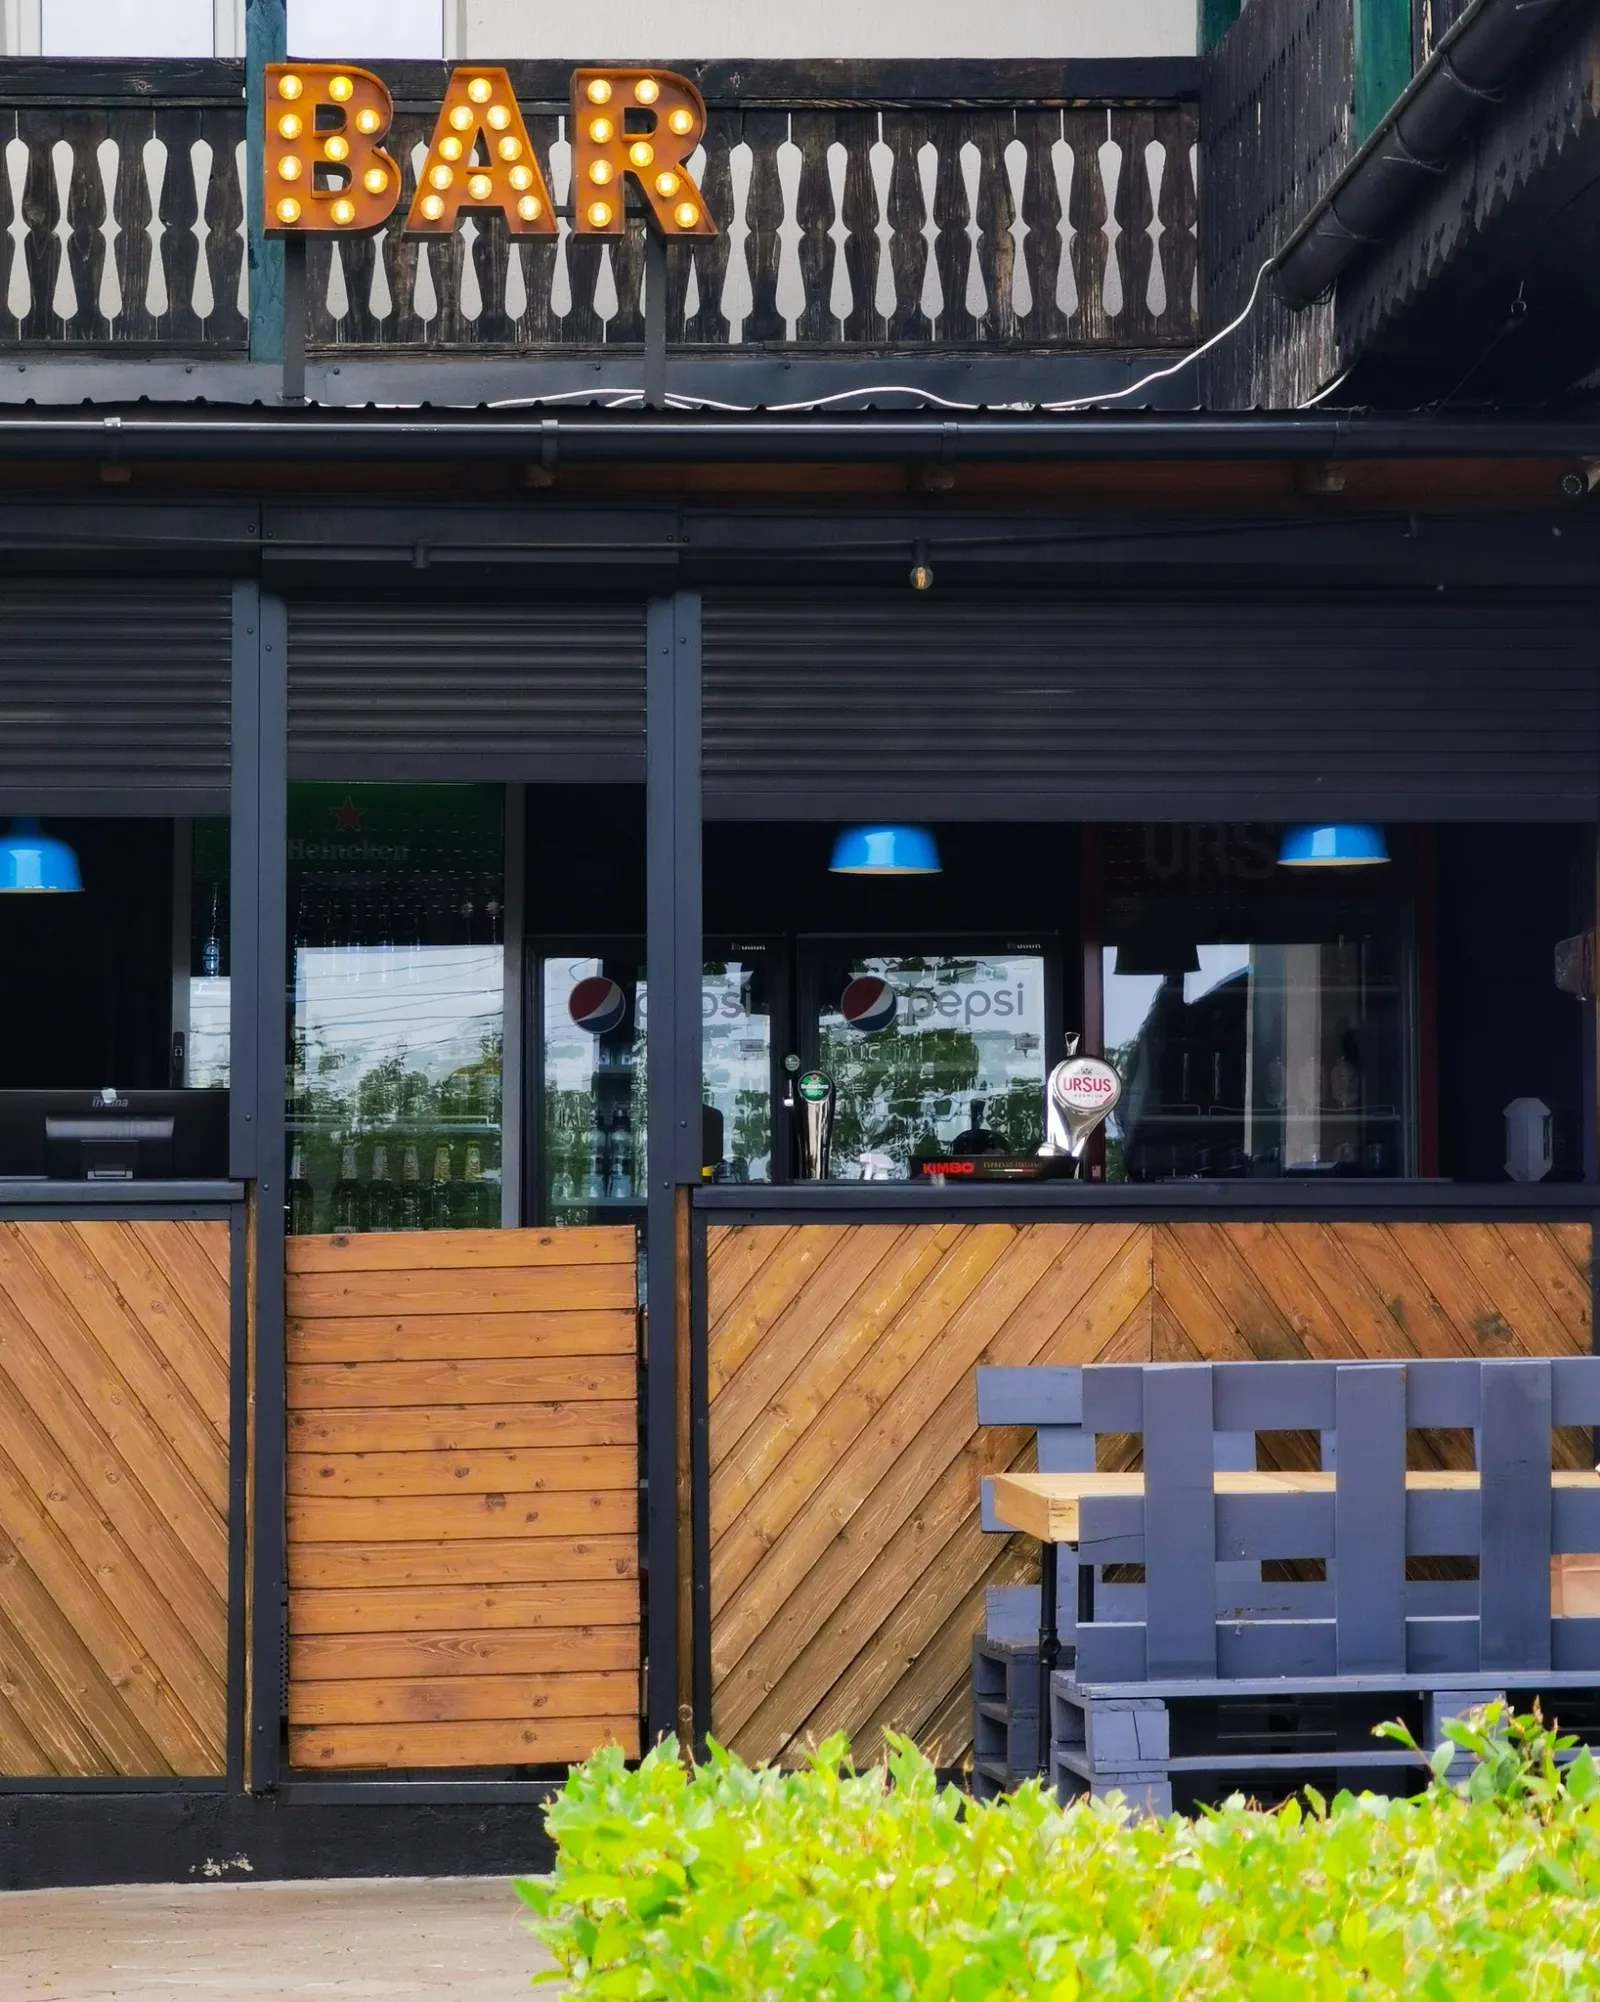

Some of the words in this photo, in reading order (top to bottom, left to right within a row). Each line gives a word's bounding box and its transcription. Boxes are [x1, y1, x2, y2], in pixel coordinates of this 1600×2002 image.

[264, 63, 719, 240] BAR
[286, 837, 409, 860] Heineken
[1144, 822, 1365, 879] URS
[907, 982, 1024, 1025] pepsi
[1063, 1076, 1112, 1092] URSUS
[923, 1162, 975, 1174] KIMBO
